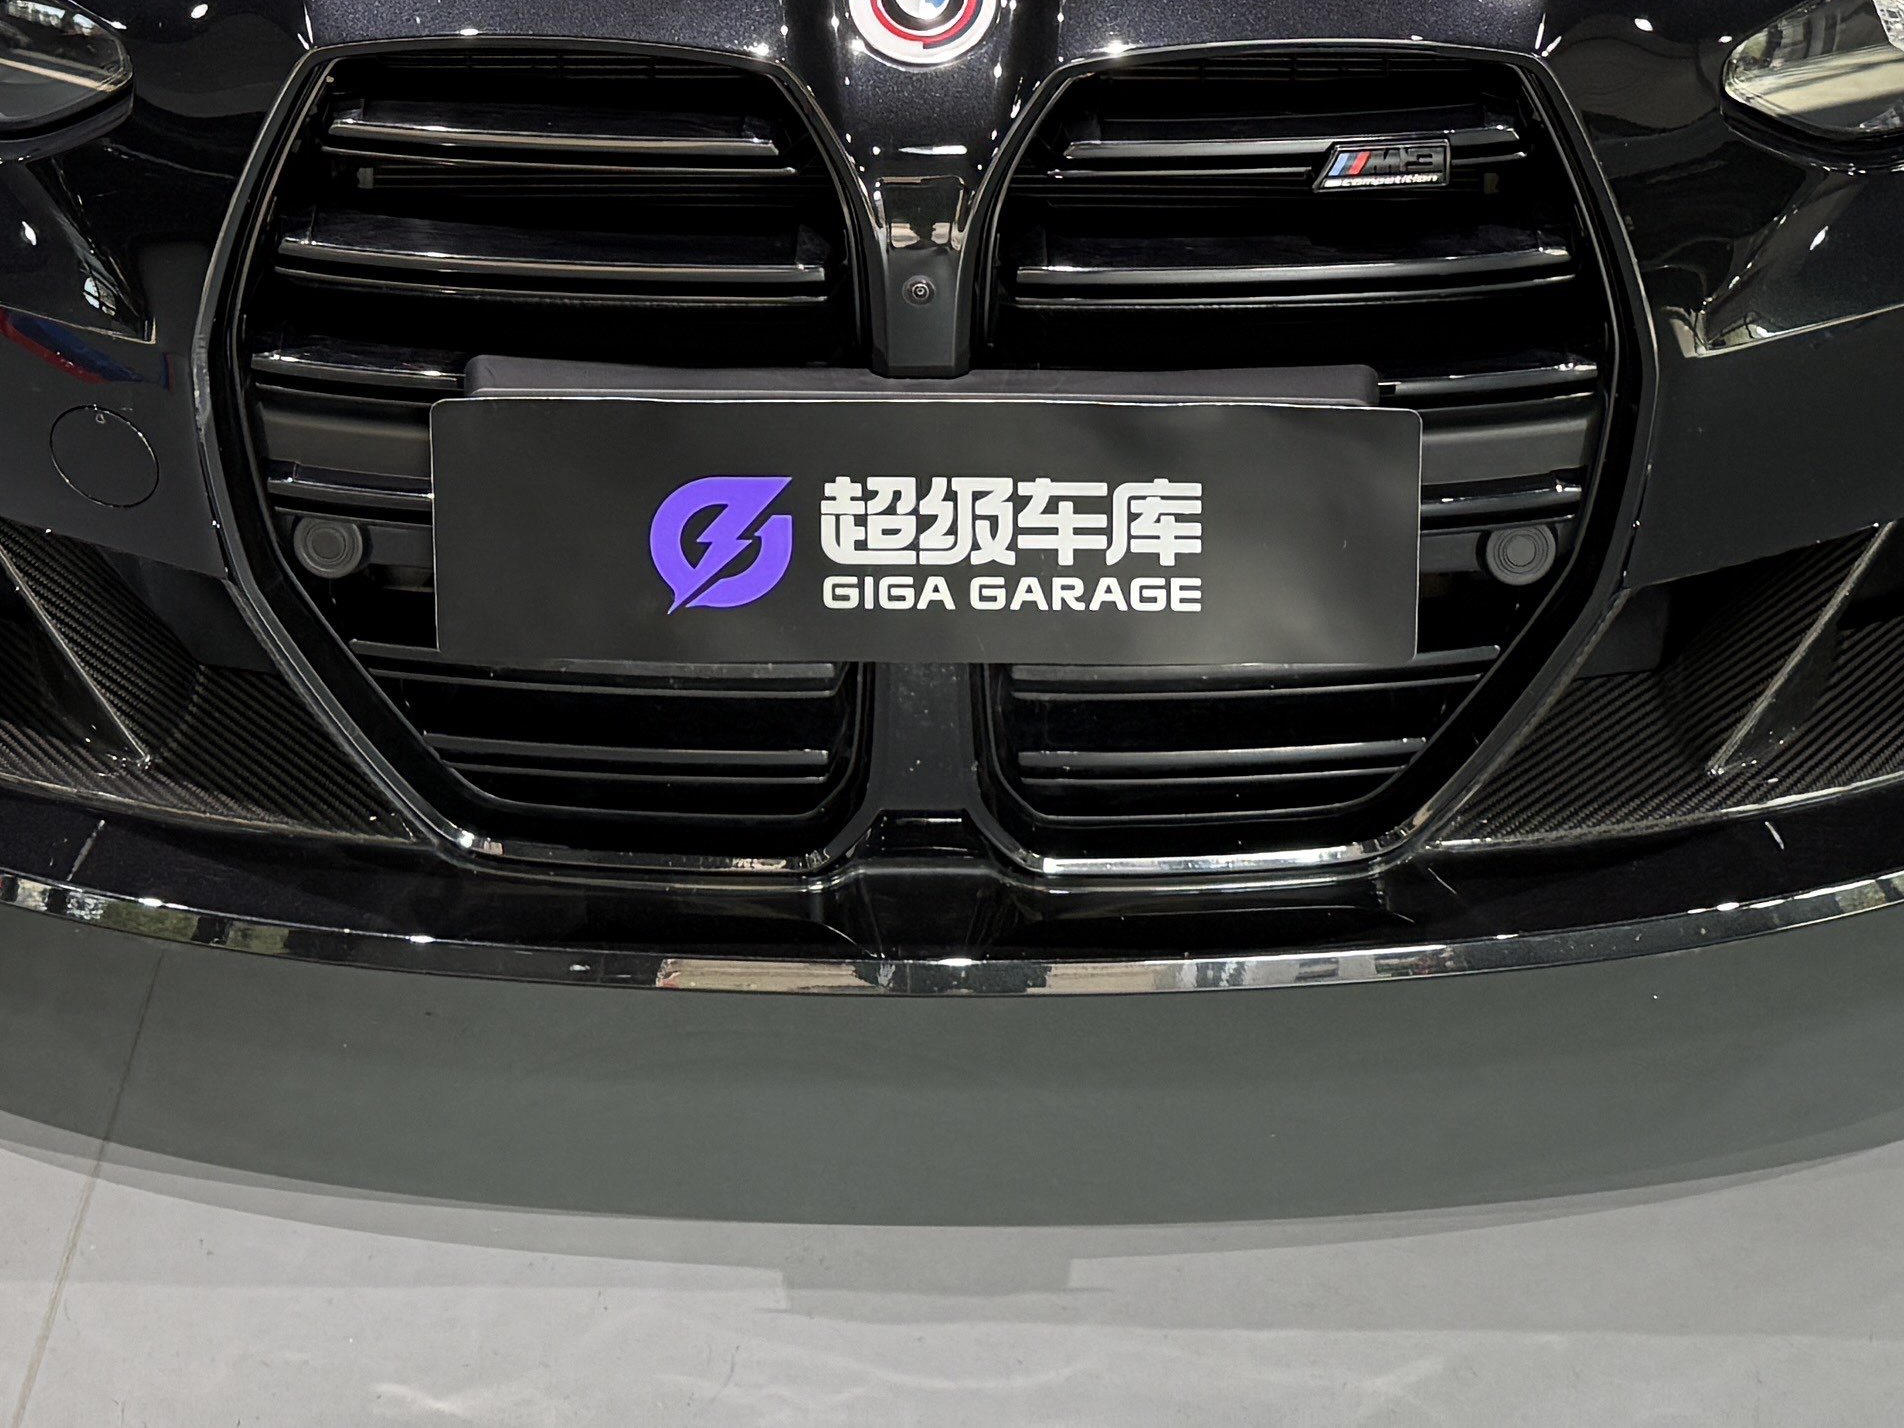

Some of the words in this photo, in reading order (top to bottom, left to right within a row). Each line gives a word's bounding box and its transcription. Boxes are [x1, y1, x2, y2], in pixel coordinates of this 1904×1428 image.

[821, 476, 1203, 567] 超级车库
[822, 576, 955, 611] GIGA
[969, 576, 1202, 612] GARAGE
